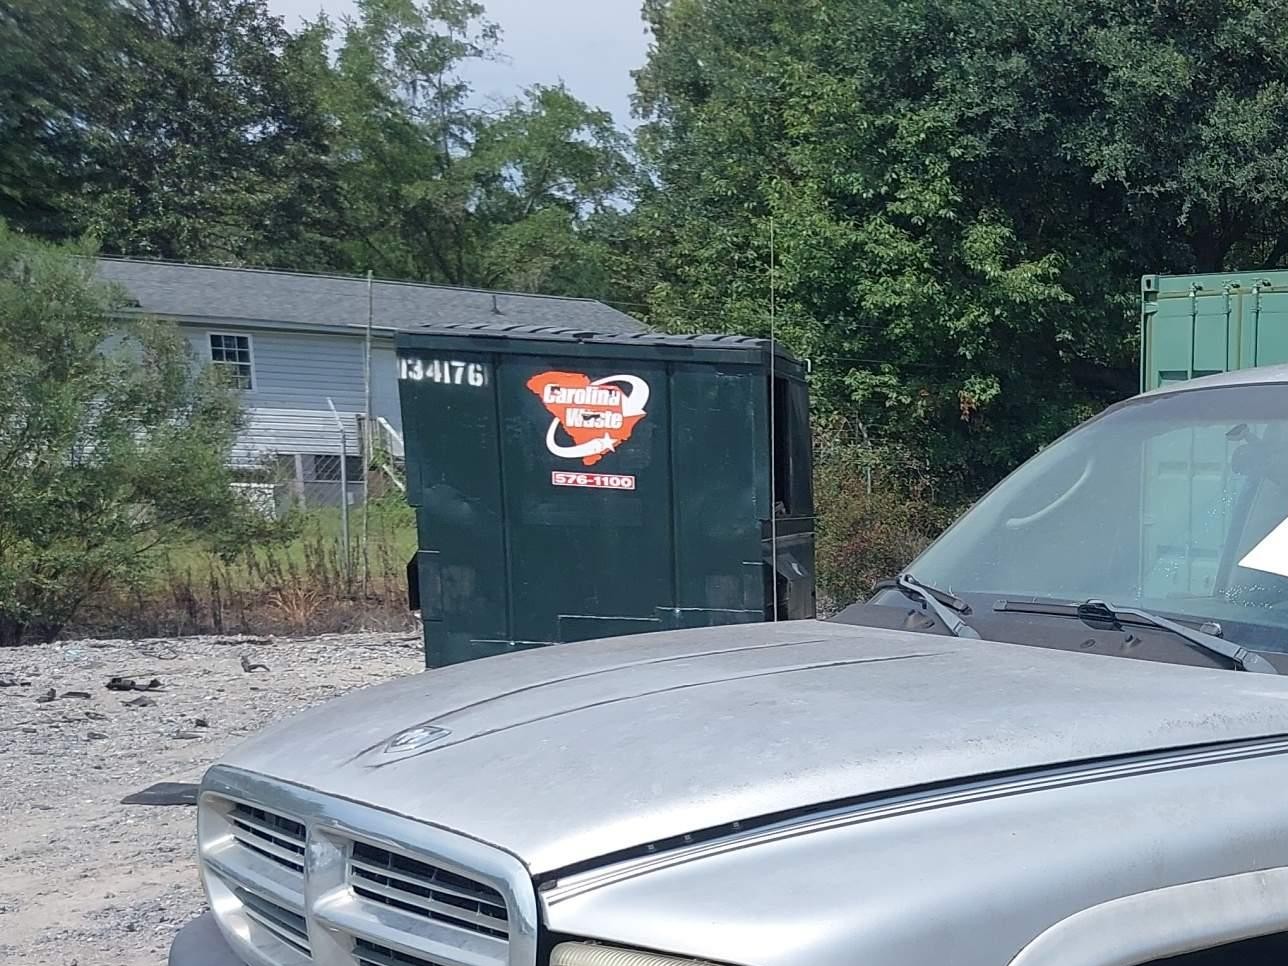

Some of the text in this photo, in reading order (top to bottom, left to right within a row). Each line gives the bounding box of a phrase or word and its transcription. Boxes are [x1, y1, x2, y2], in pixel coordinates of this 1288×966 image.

[401, 358, 484, 387] 134176
[543, 384, 621, 406] Carolina
[565, 407, 623, 429] Waste
[555, 473, 632, 488] 576-1100
